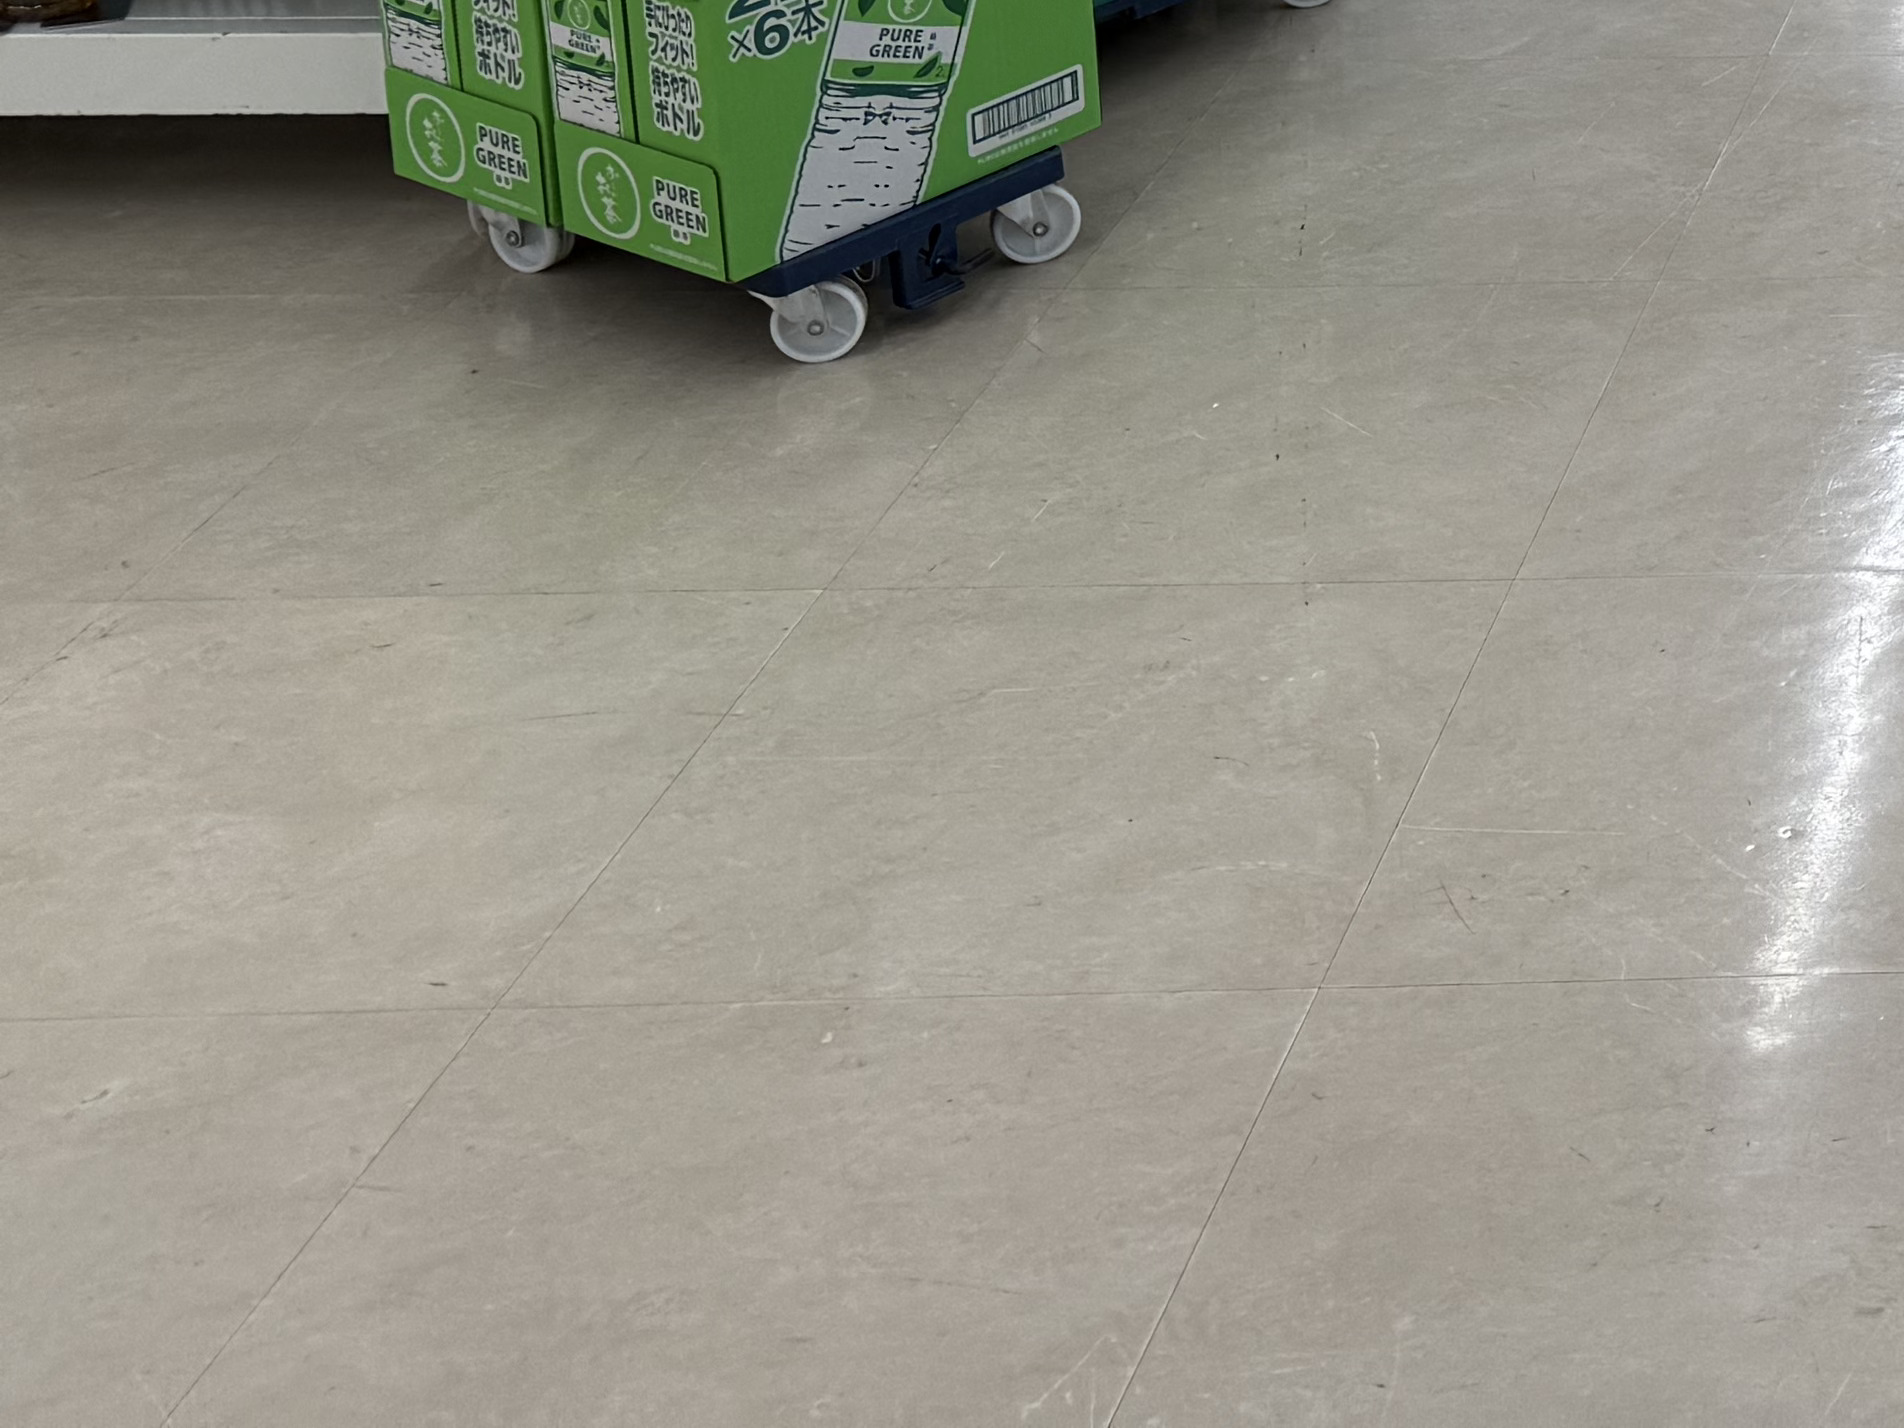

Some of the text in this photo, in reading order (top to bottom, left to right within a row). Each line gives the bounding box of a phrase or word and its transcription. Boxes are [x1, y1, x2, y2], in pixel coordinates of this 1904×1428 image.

[879, 28, 923, 42] PURE
[870, 44, 923, 59] GREEN
[476, 51, 523, 89] ボトル
[655, 101, 701, 138] ボトル
[478, 125, 521, 154] PURE
[475, 144, 528, 180] GREEN
[652, 180, 701, 208] PURE
[651, 199, 708, 236] GREEN
